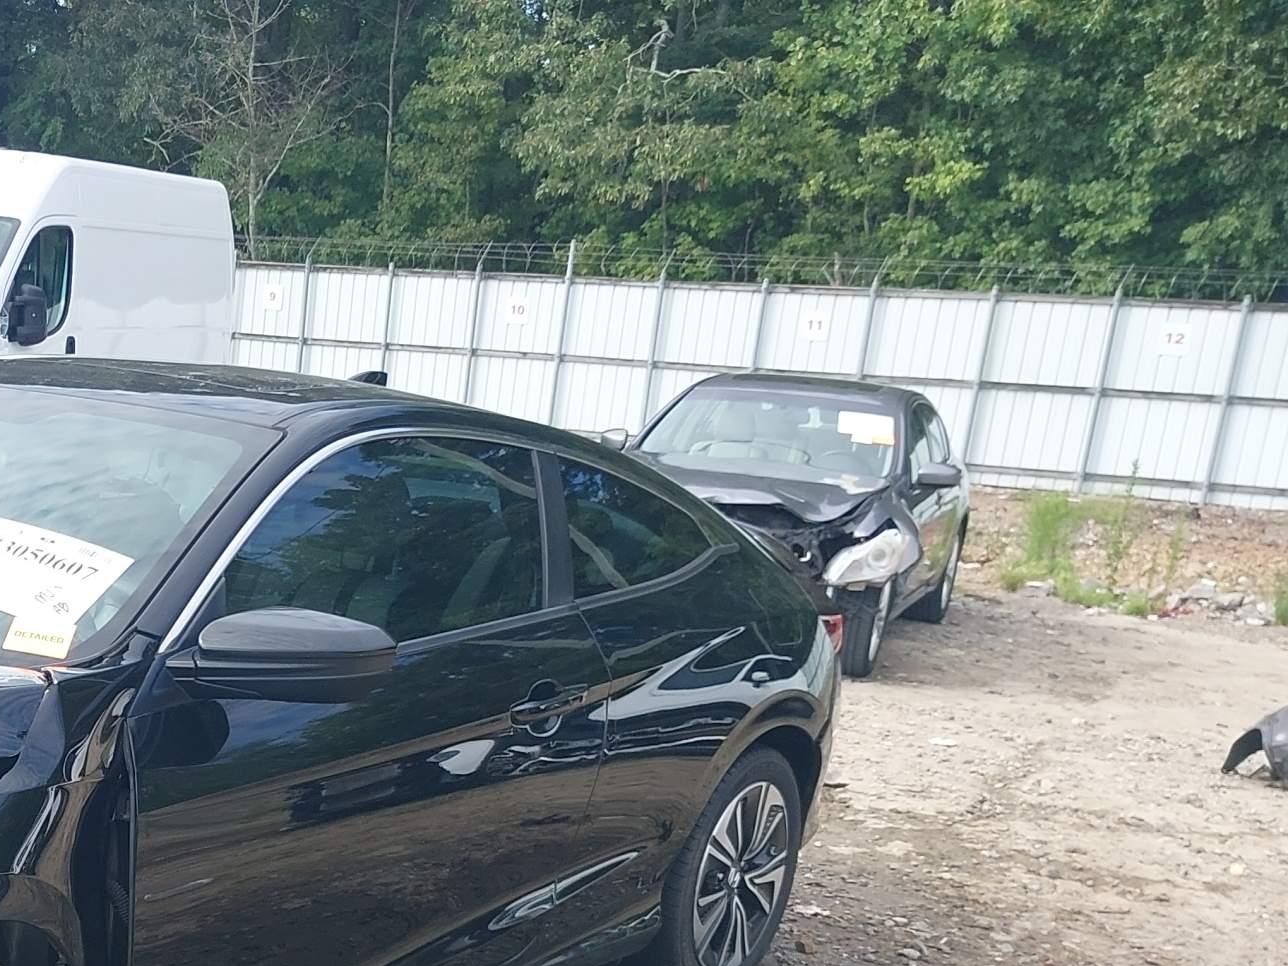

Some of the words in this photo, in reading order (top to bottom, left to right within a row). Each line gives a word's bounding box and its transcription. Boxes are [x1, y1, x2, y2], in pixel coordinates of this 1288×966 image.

[512, 304, 525, 315] 10
[808, 320, 822, 330] 11
[1166, 333, 1185, 344] 12
[14, 630, 65, 644] DETAILED
